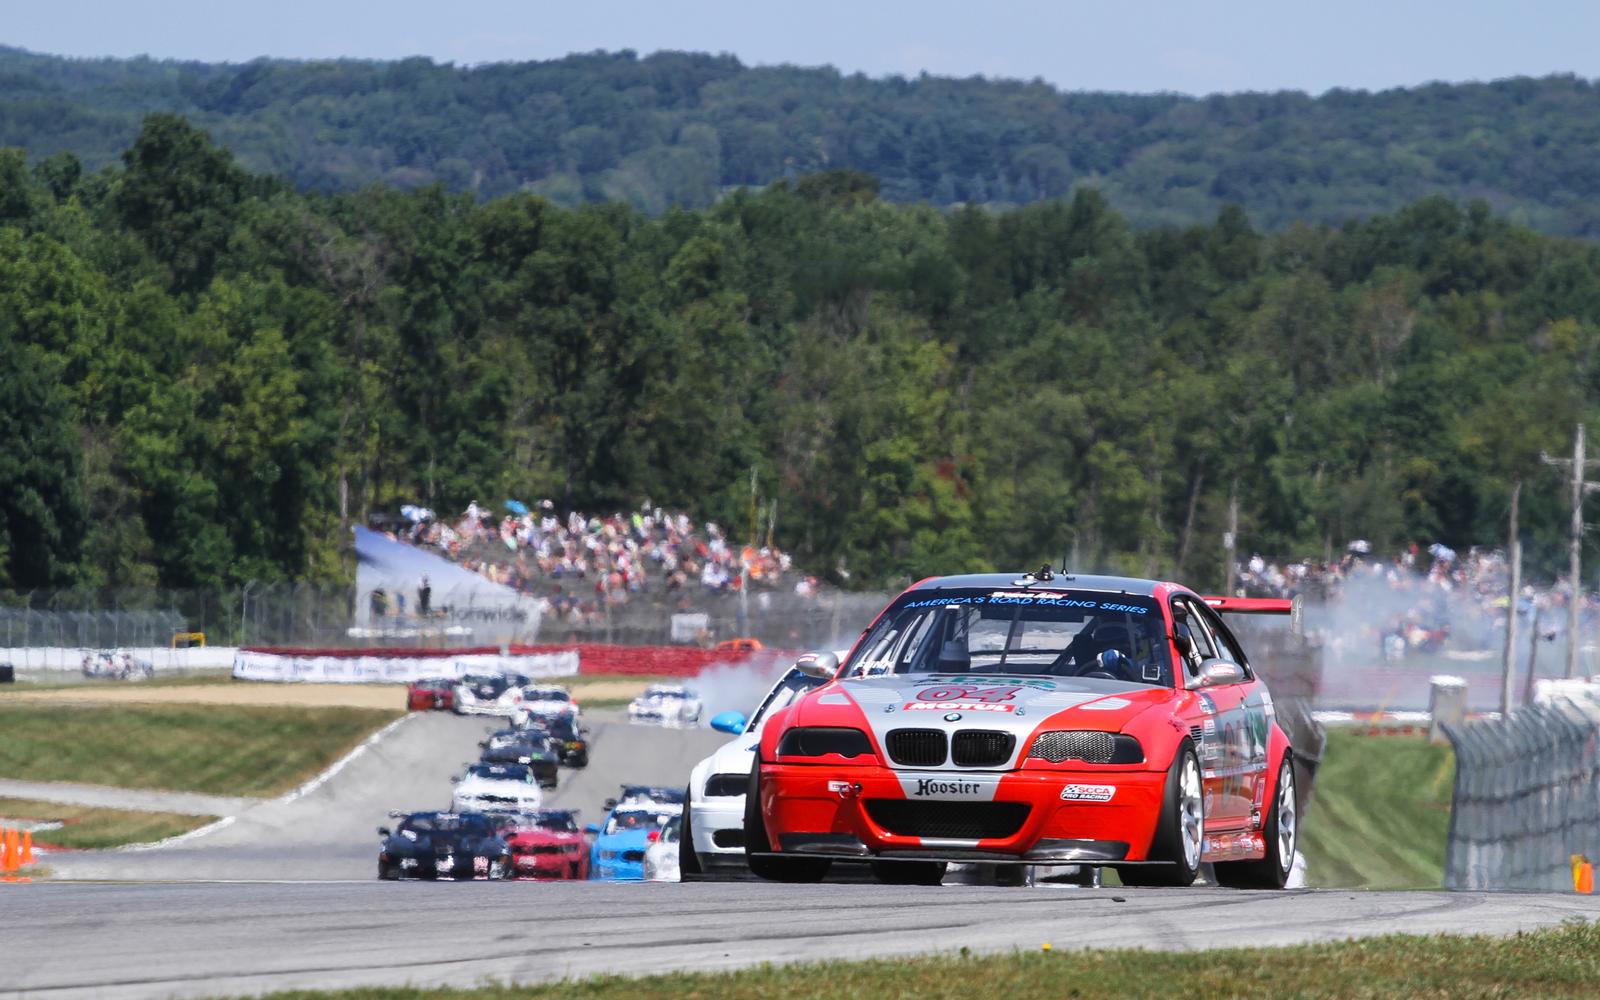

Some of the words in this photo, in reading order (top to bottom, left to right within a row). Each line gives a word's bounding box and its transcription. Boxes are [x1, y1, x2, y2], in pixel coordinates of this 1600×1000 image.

[904, 597, 984, 609] AMERICA'S
[989, 597, 1034, 605] ROAD
[1038, 597, 1096, 608] RACING
[1100, 602, 1149, 614] SERIES
[909, 702, 1009, 712] MOTUL
[914, 779, 980, 796] Hoosier
